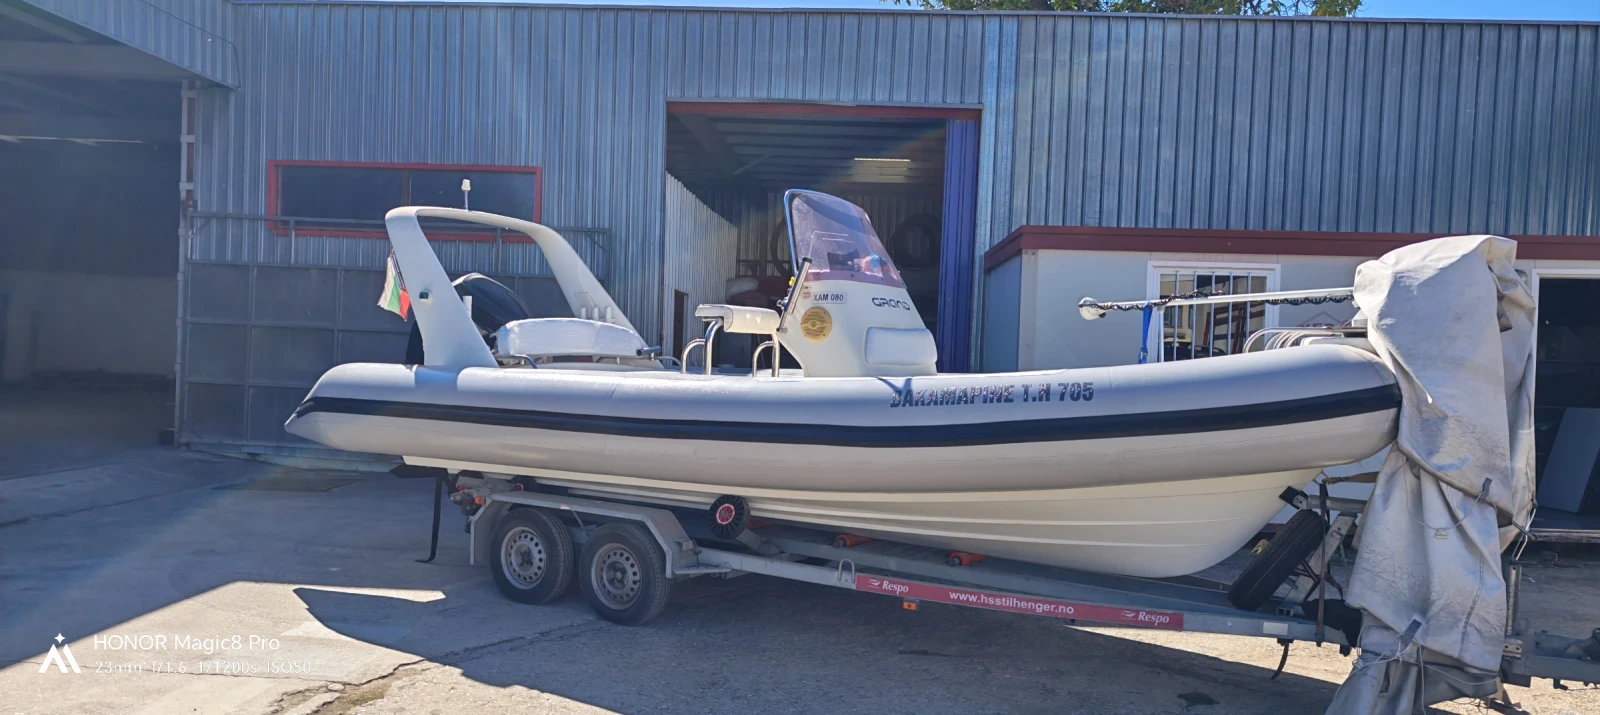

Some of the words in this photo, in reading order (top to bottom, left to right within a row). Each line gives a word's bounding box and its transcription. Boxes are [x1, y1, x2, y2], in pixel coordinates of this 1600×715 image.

[813, 293, 829, 302] XAM
[830, 293, 844, 302] 080
[1057, 381, 1094, 402] 705
[881, 580, 909, 594] Respo
[948, 590, 1075, 615] www.hsstilhenger.no
[1137, 611, 1170, 625] Respo
